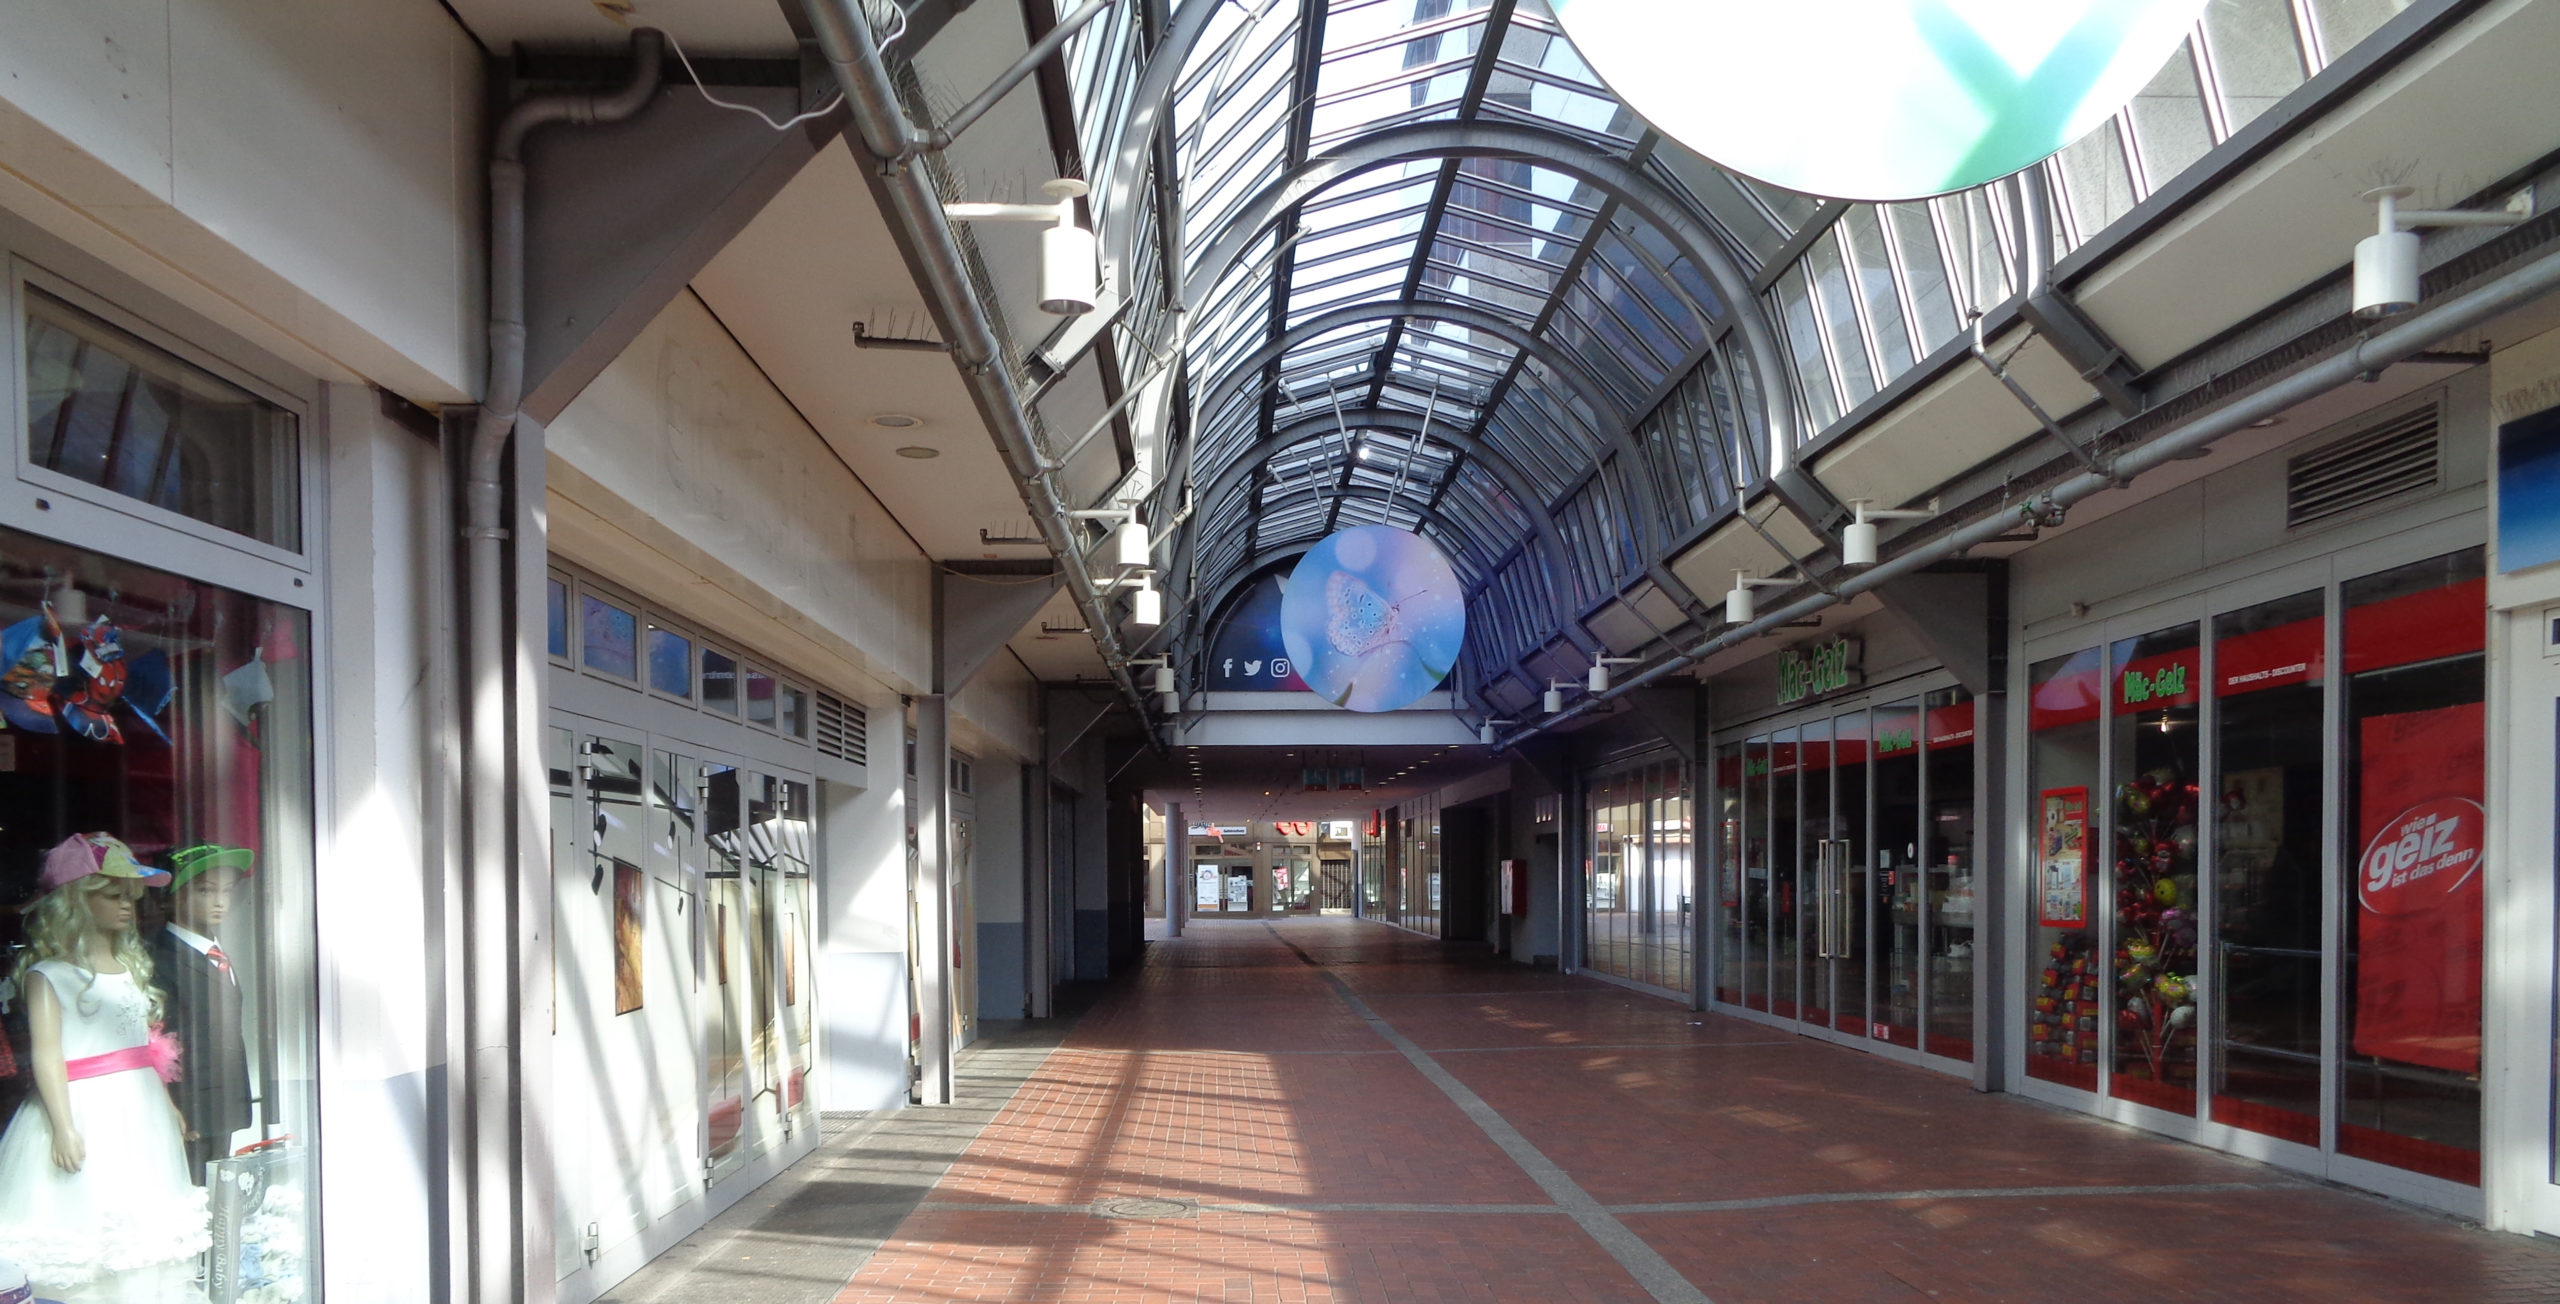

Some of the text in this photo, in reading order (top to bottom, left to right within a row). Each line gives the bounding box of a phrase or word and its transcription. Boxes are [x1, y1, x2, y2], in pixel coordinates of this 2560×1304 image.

[1778, 634, 1848, 705] Mäc-Geiz
[2124, 663, 2185, 704] Mäc-Geiz
[2368, 813, 2460, 892] geiz
[2401, 816, 2426, 836] wie
[2392, 847, 2474, 888] ist das denn
[212, 1206, 230, 1289] Happy Baby
